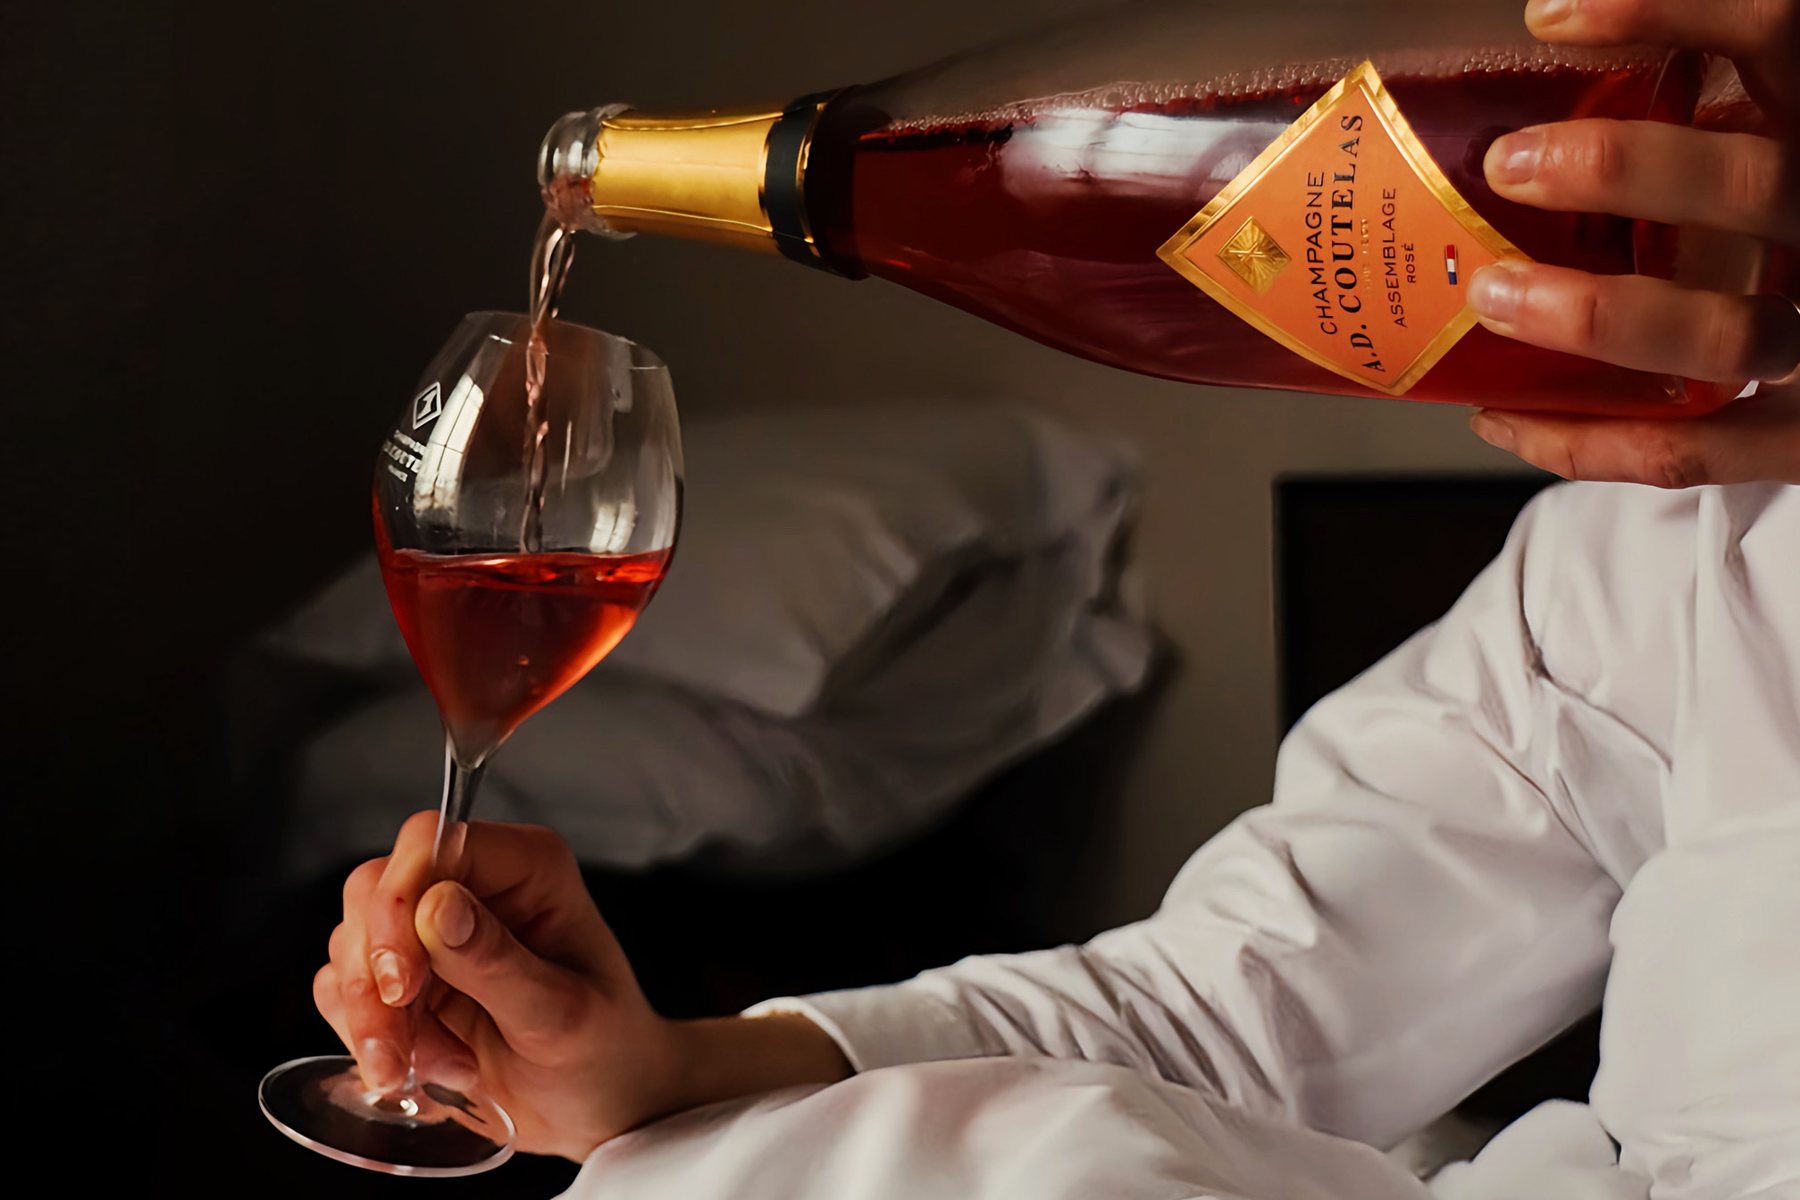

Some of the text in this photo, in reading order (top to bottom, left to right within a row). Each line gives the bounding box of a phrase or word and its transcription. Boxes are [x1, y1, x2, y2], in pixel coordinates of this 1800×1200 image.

[1305, 171, 1338, 335] CHAMPAGNE
[1331, 115, 1364, 314] COUTELAS
[1381, 187, 1408, 328] ASSEMBLAGE
[1403, 242, 1417, 284] ROSÉ
